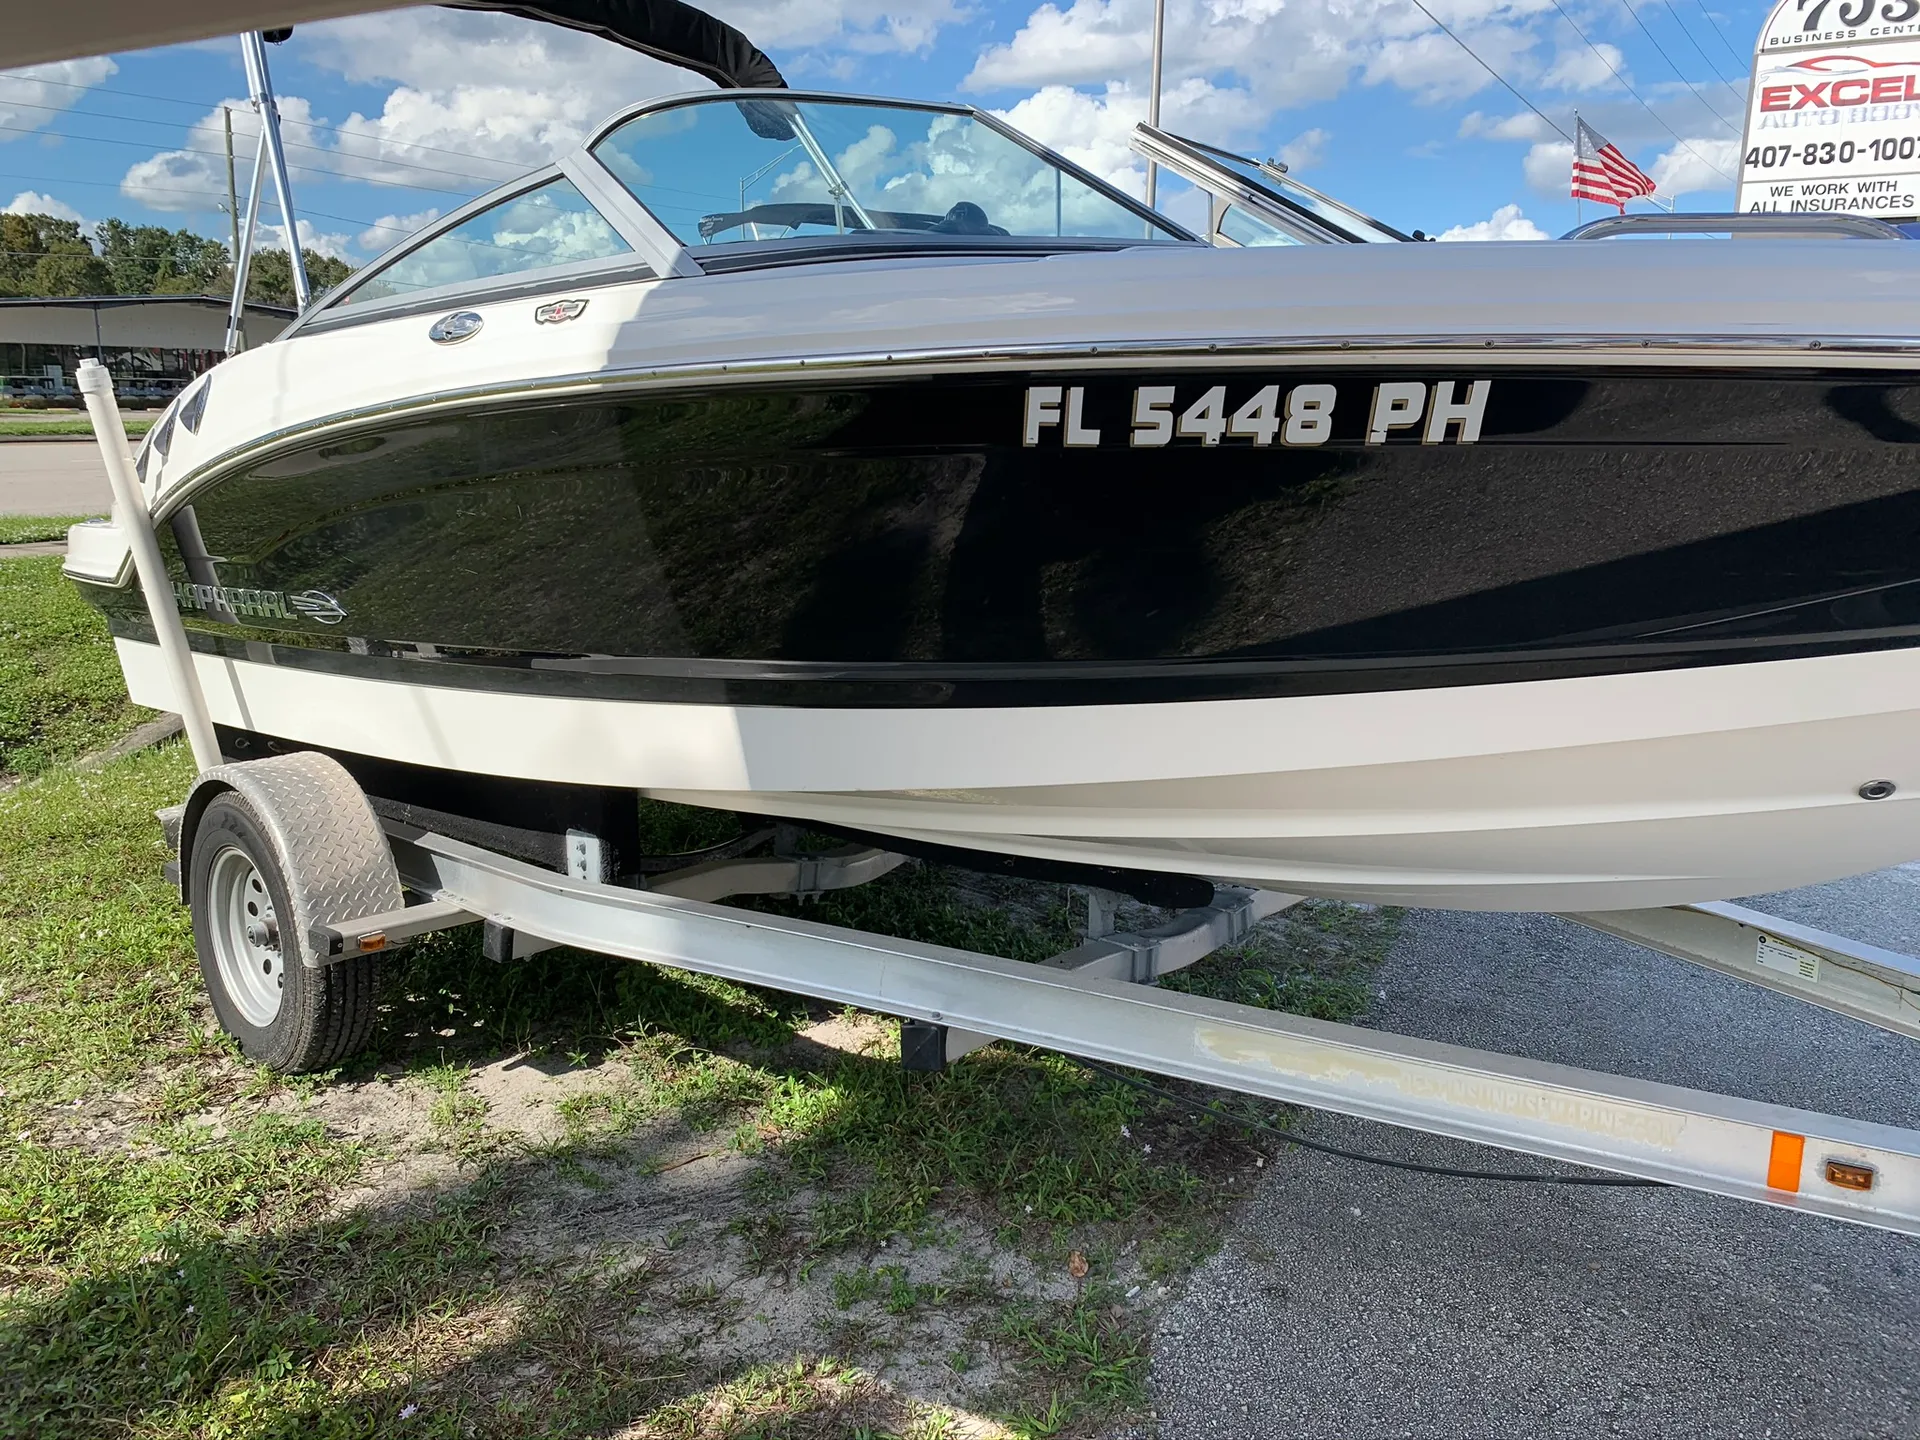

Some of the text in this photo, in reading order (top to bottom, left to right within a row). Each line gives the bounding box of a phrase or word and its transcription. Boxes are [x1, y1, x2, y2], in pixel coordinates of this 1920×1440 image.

[1770, 24, 1920, 45] BUSINESS CENT
[1757, 108, 1840, 130] AUTO
[1745, 136, 1920, 168] 407-830-100
[1770, 180, 1898, 197] WE WORK WITH
[1750, 194, 1915, 214] ALL INSURANCES
[1022, 380, 1492, 447] FL 5448 PH
[172, 581, 298, 621] HAPARRAL
